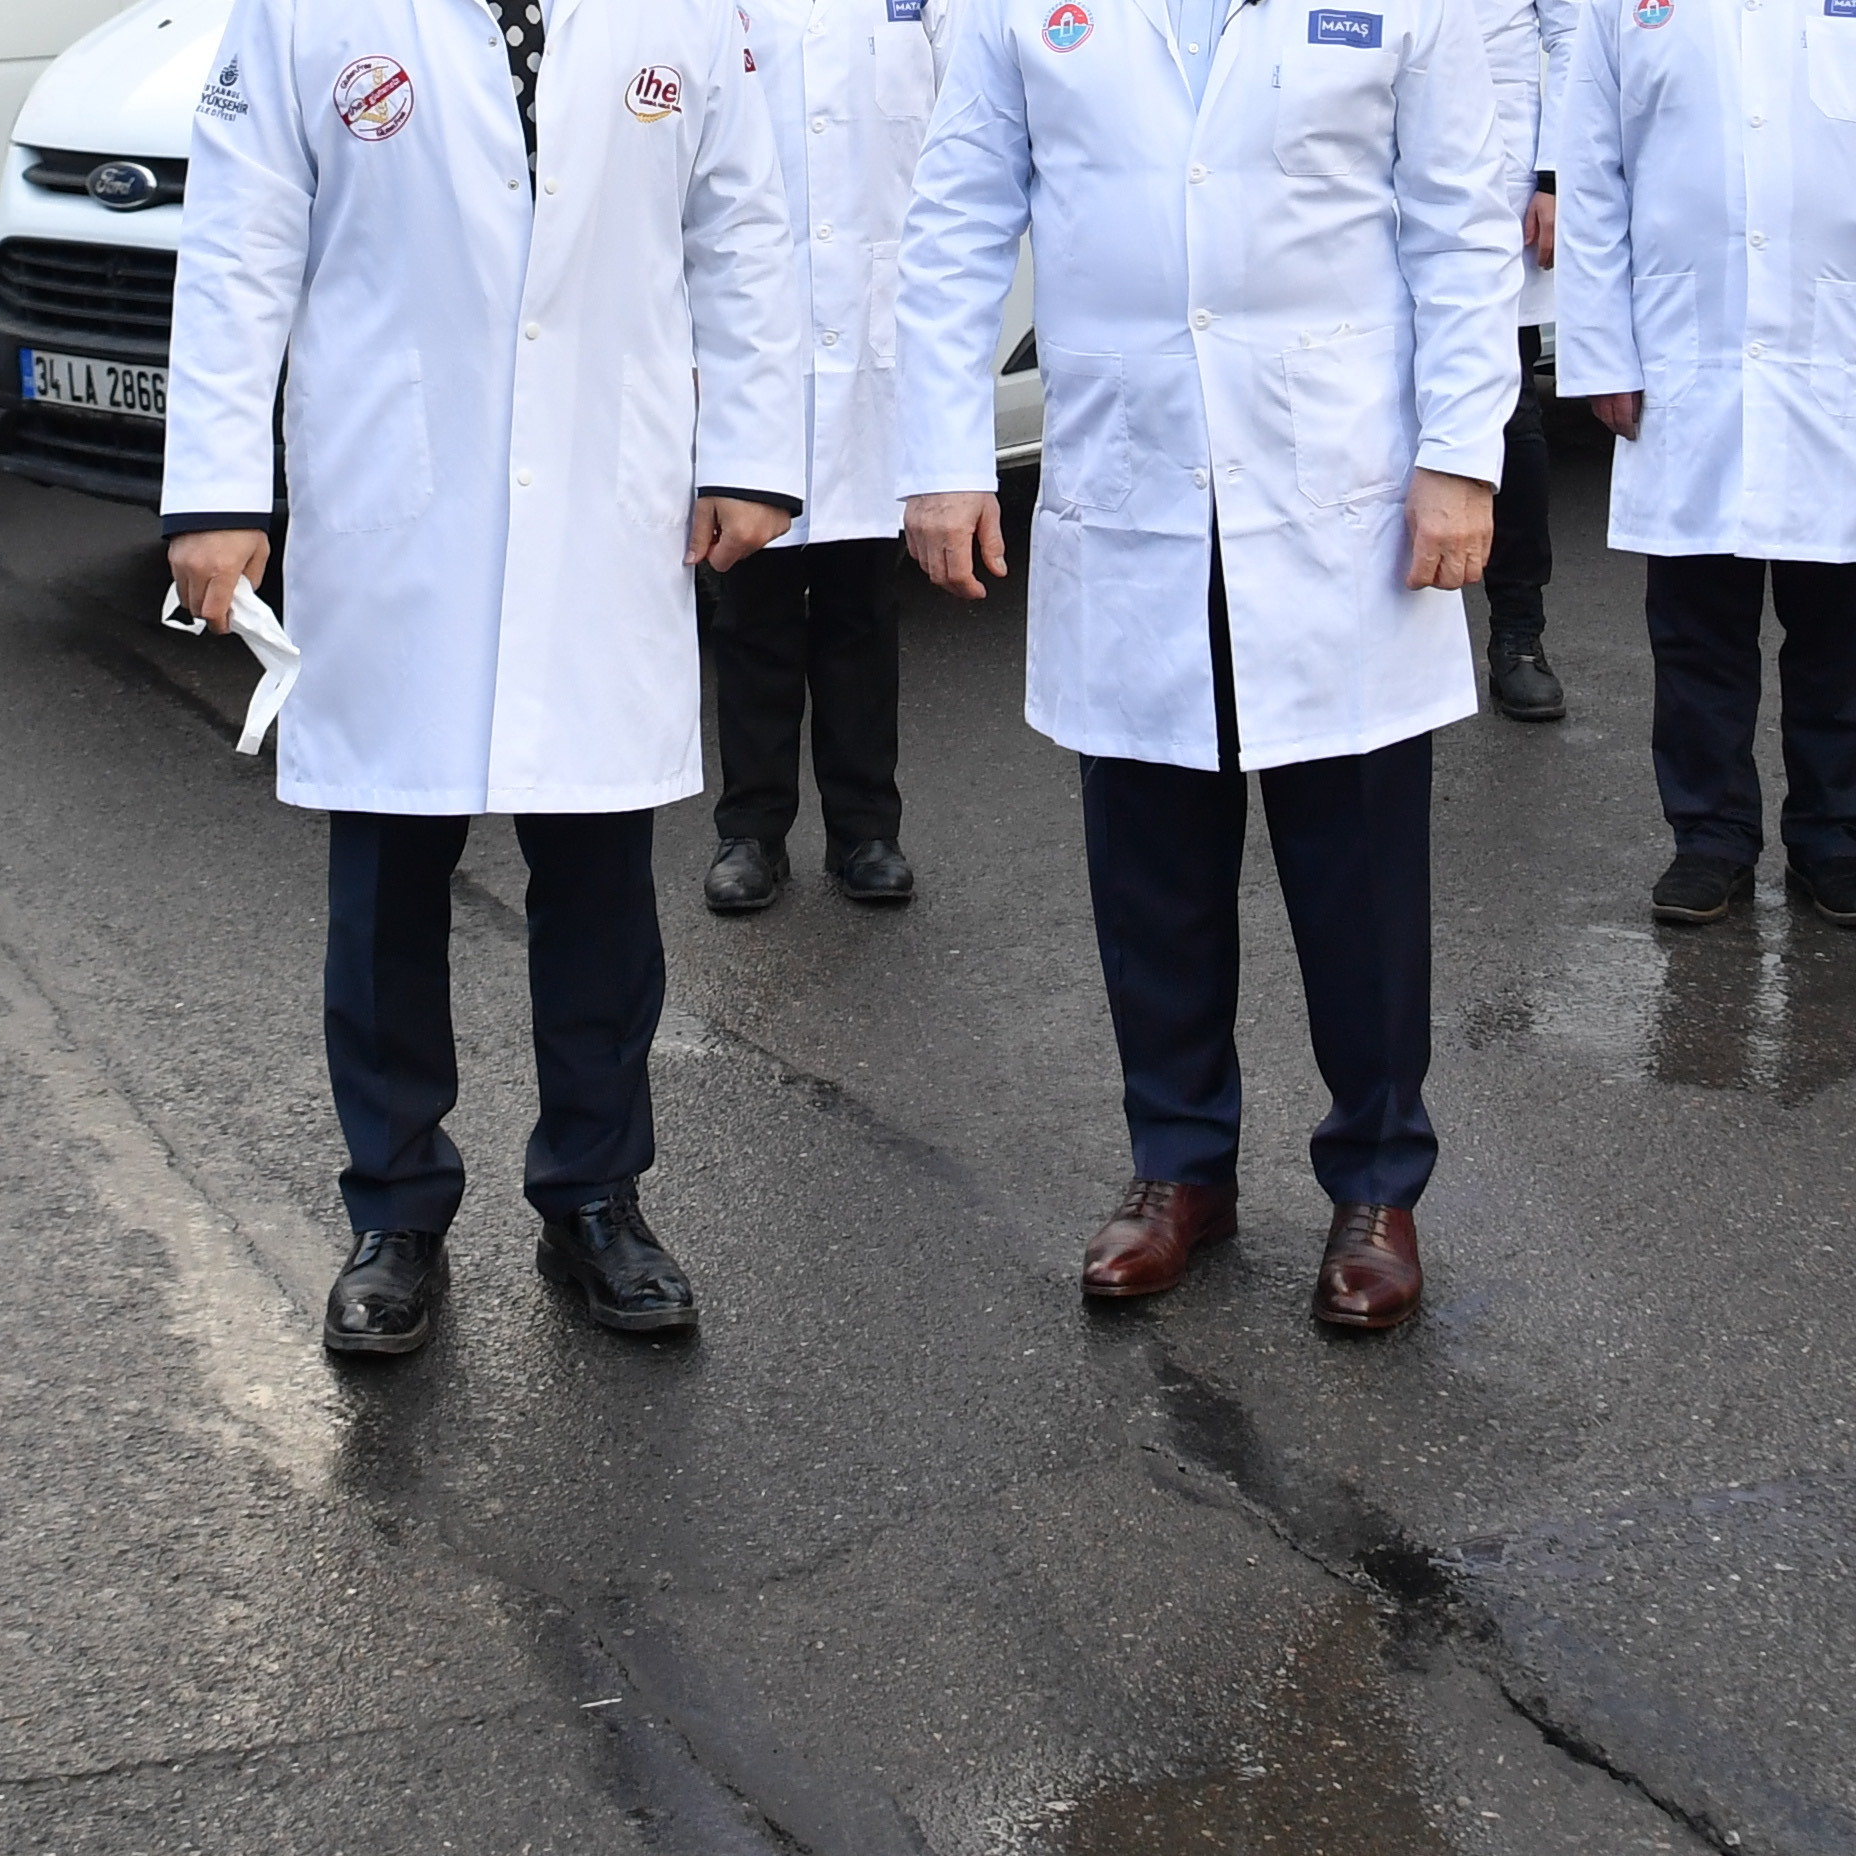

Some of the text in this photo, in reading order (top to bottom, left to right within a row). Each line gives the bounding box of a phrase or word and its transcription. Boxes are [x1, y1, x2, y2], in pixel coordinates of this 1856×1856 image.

[896, 2, 921, 12] MATA
[1321, 20, 1369, 38] MATAŞ
[635, 68, 678, 103] ihe
[95, 167, 136, 195] Ford
[35, 356, 167, 415] 34 LA 2866
